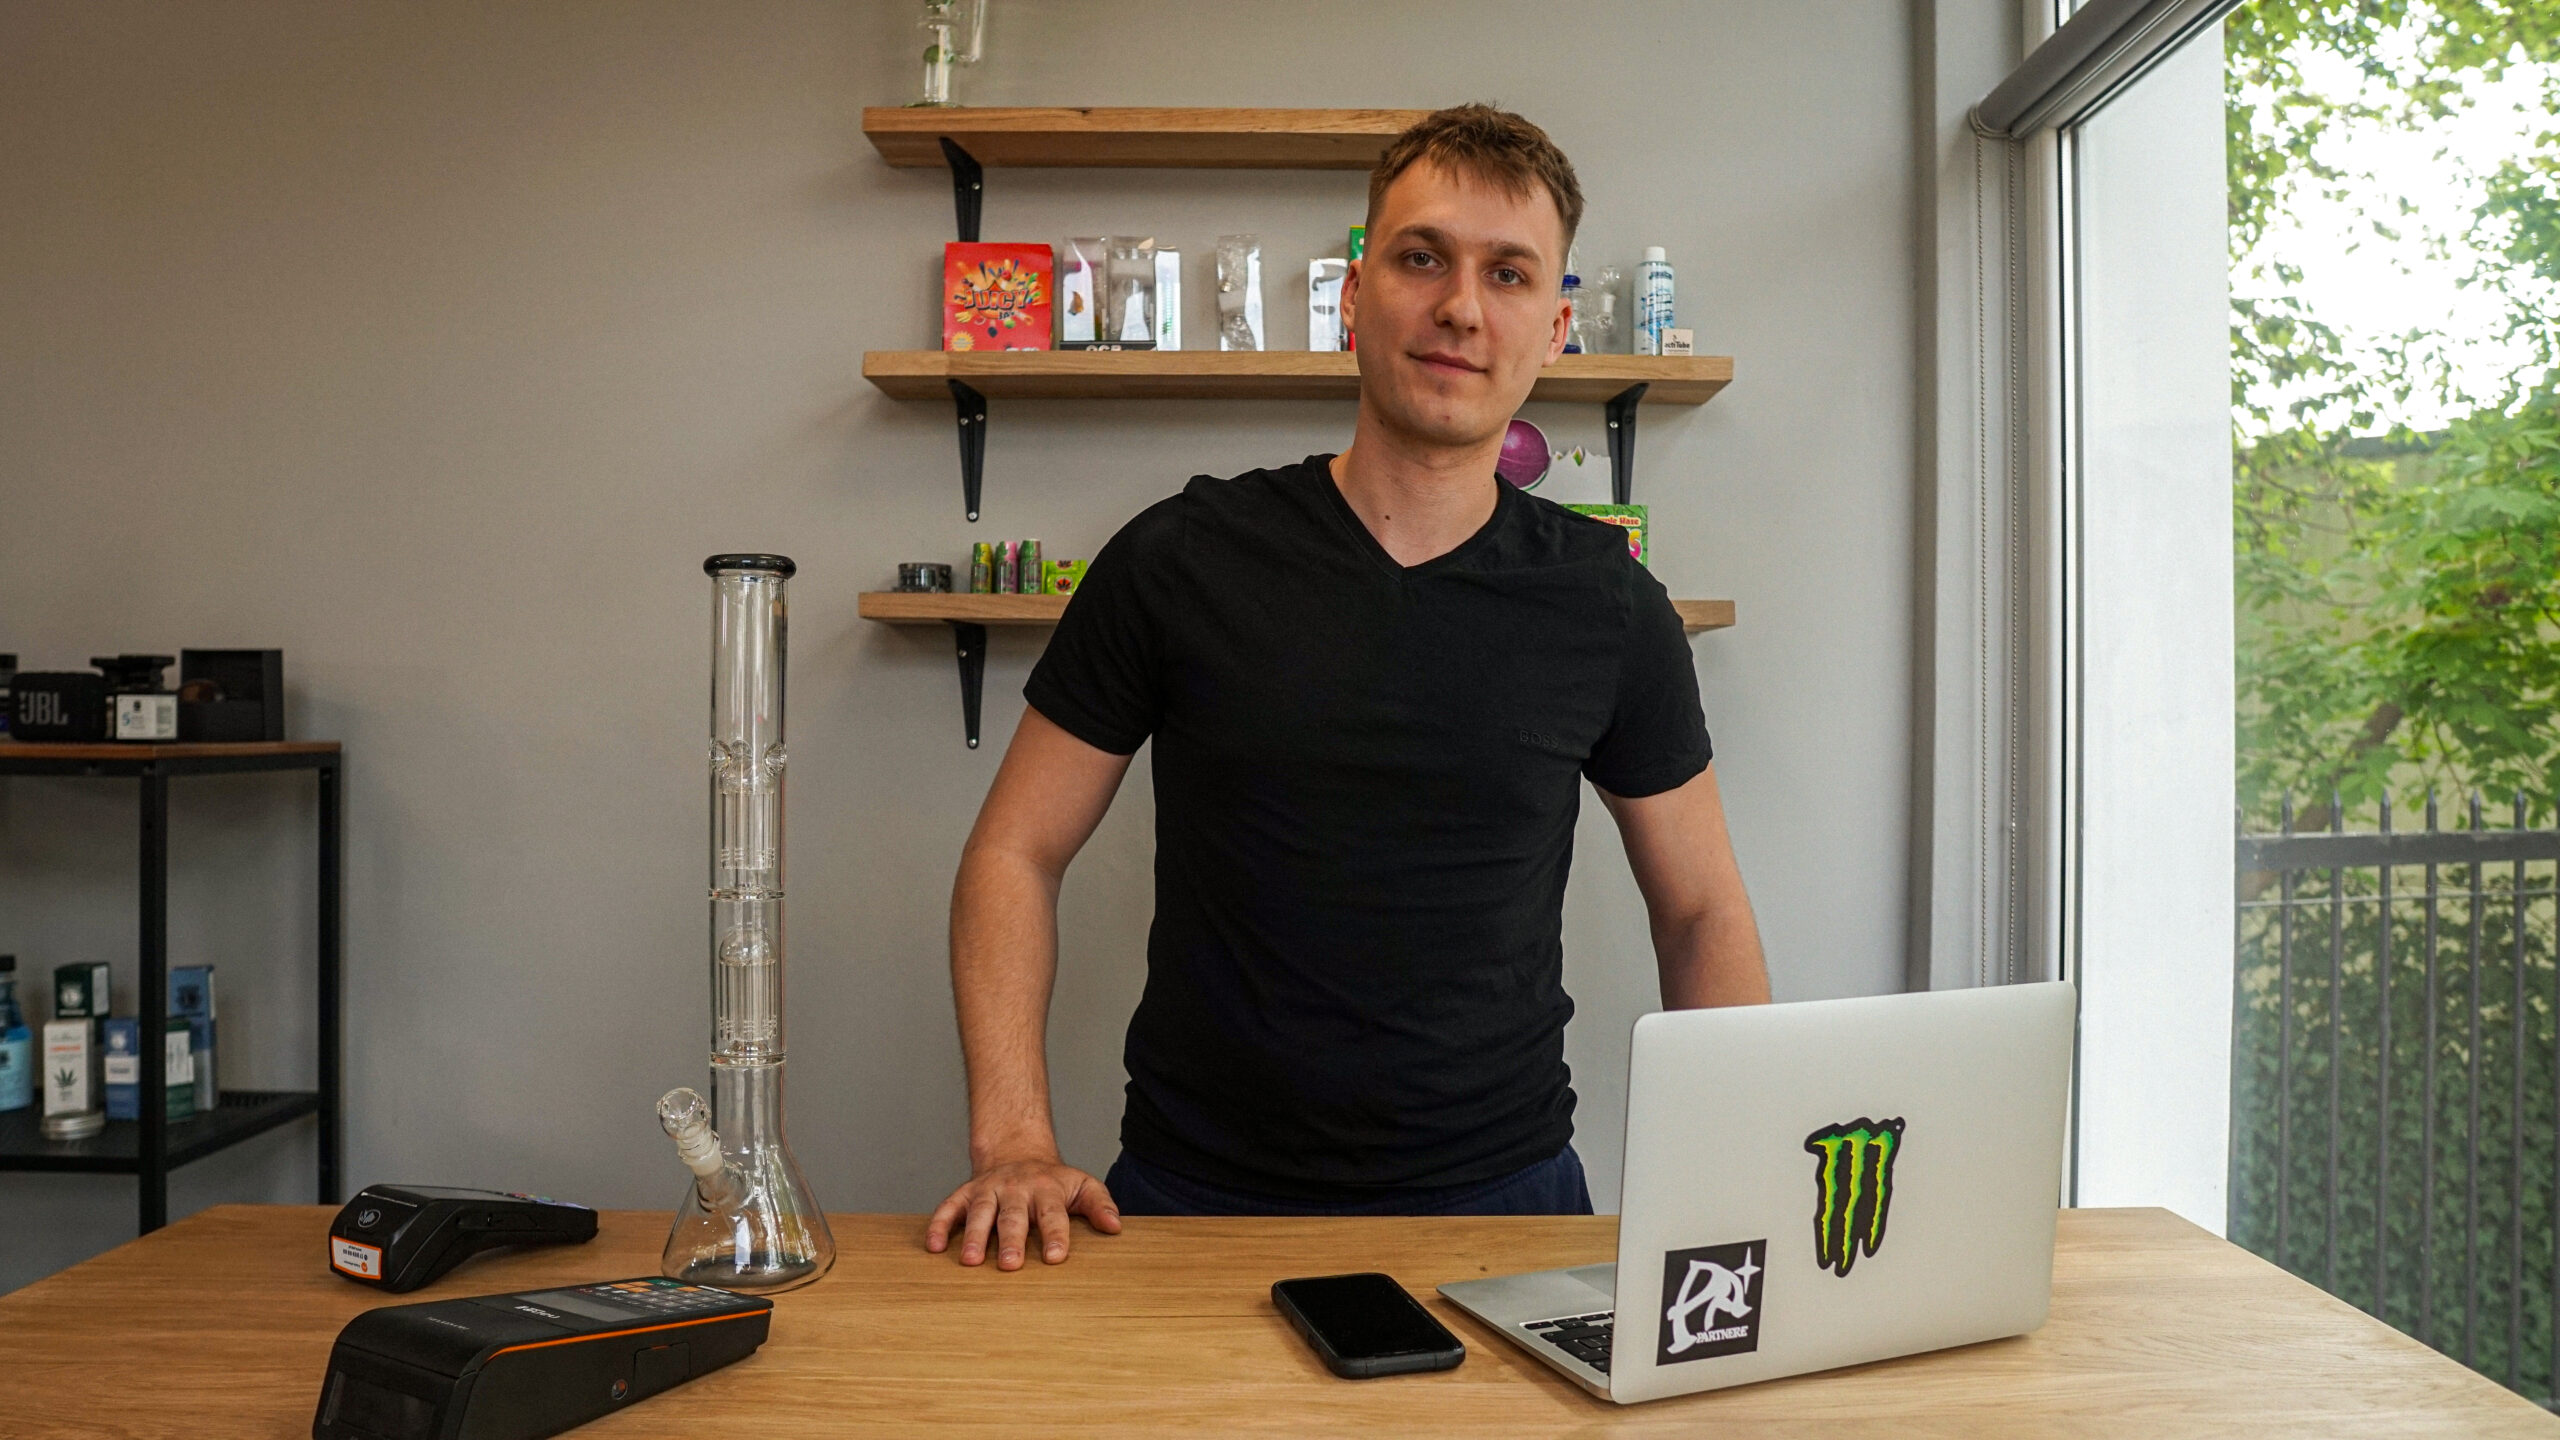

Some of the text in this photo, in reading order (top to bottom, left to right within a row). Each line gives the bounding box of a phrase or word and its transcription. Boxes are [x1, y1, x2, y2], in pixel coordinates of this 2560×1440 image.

[964, 289, 1028, 310] JUICY
[18, 690, 69, 726] JBL
[1519, 729, 1560, 749] BOSS
